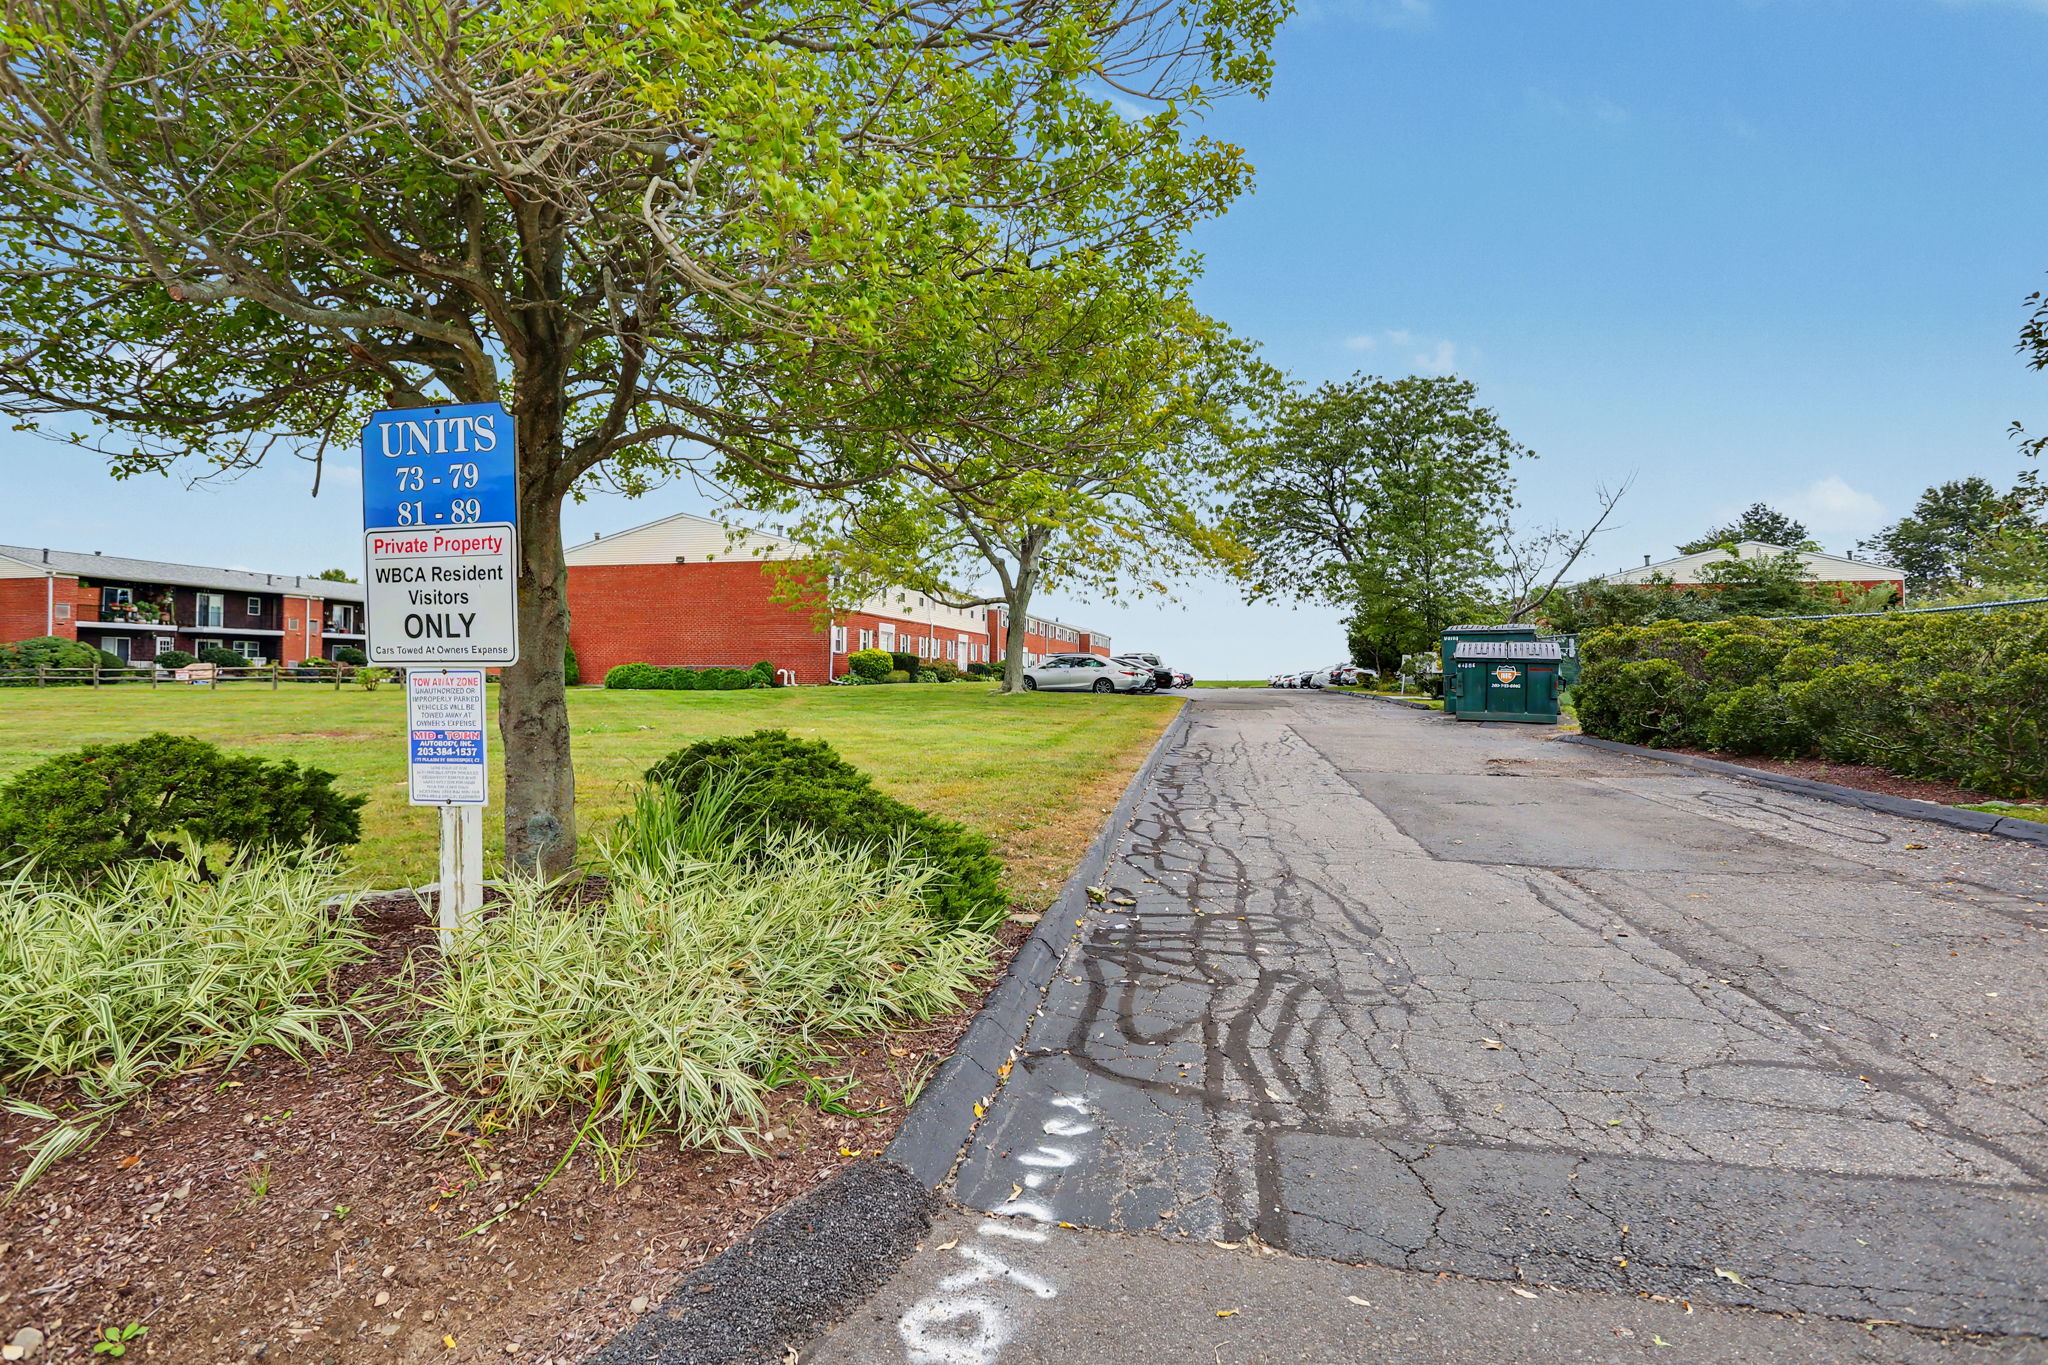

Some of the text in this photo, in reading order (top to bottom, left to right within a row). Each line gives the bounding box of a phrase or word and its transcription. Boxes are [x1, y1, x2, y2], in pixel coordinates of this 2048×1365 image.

[378, 414, 497, 458] UNITS
[396, 466, 424, 492] 73
[449, 462, 479, 489] 79
[397, 500, 426, 527] 81
[451, 498, 481, 524] 89
[374, 535, 503, 555] Private Property
[375, 565, 503, 583] WBCA Resident
[408, 590, 469, 605] Visitors
[404, 612, 476, 639] ONLY
[376, 645, 508, 656] Cars Towed At Owners Expense
[413, 677, 479, 686] TOW AWAY ZONE
[413, 731, 436, 740] MID
